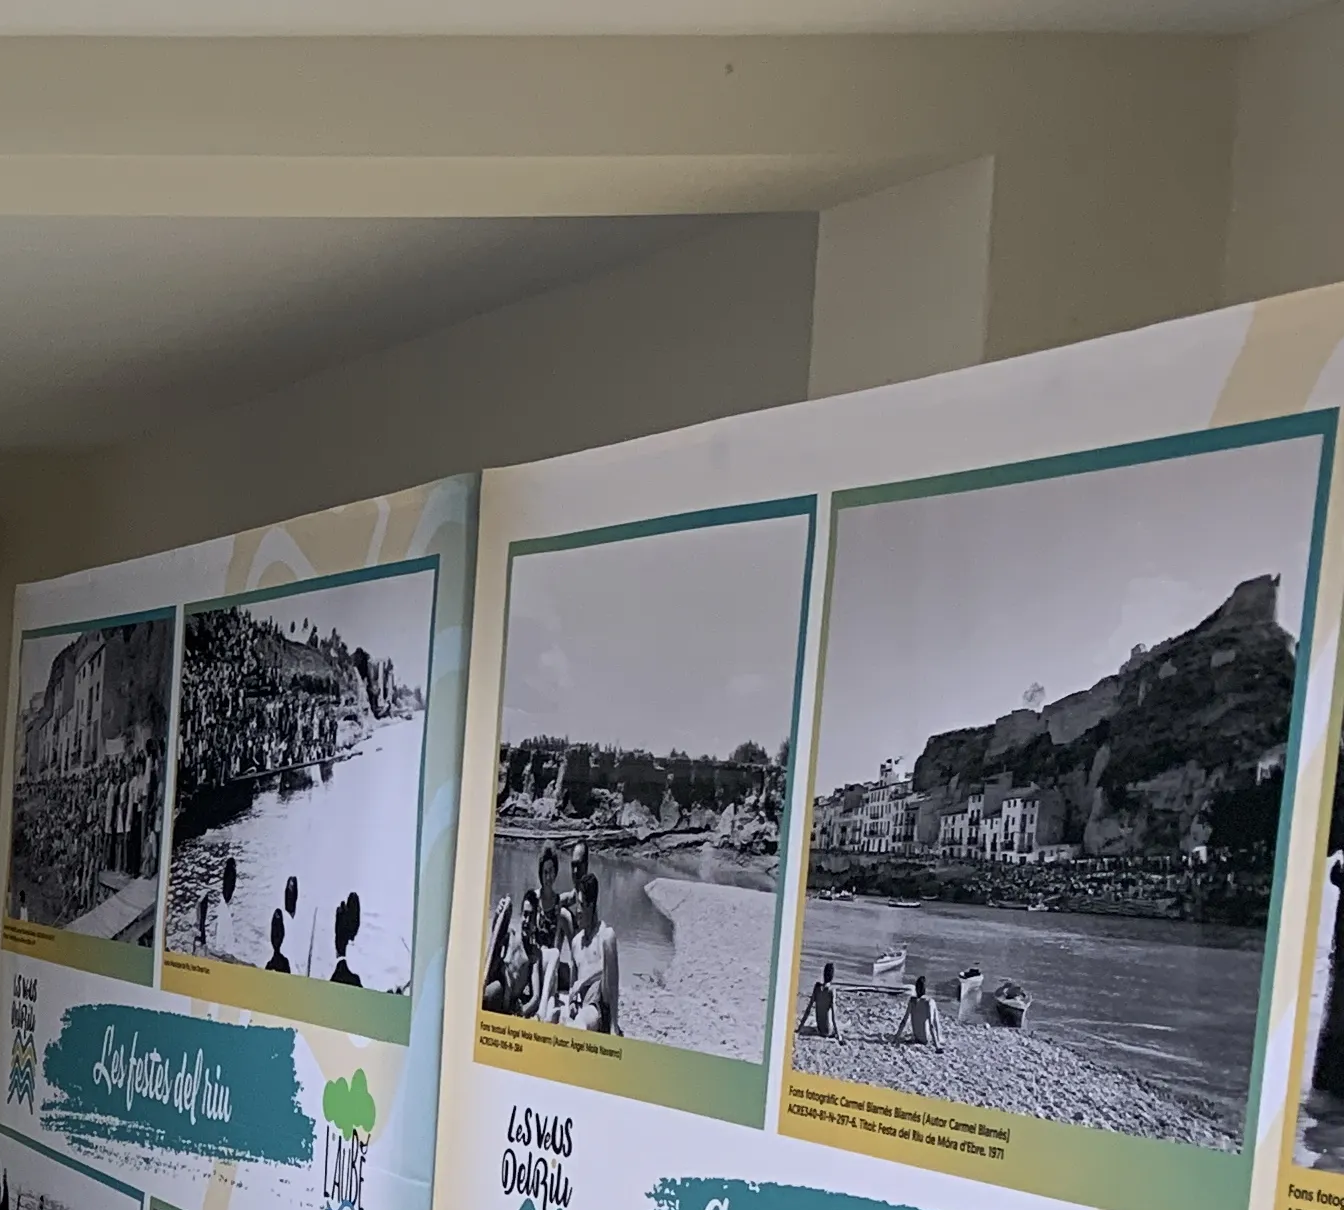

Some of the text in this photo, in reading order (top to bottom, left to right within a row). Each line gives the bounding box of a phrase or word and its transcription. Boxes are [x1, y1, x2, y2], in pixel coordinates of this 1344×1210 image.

[92, 1024, 234, 1126] Les festes del riu
[1287, 1183, 1314, 1202] Fons
